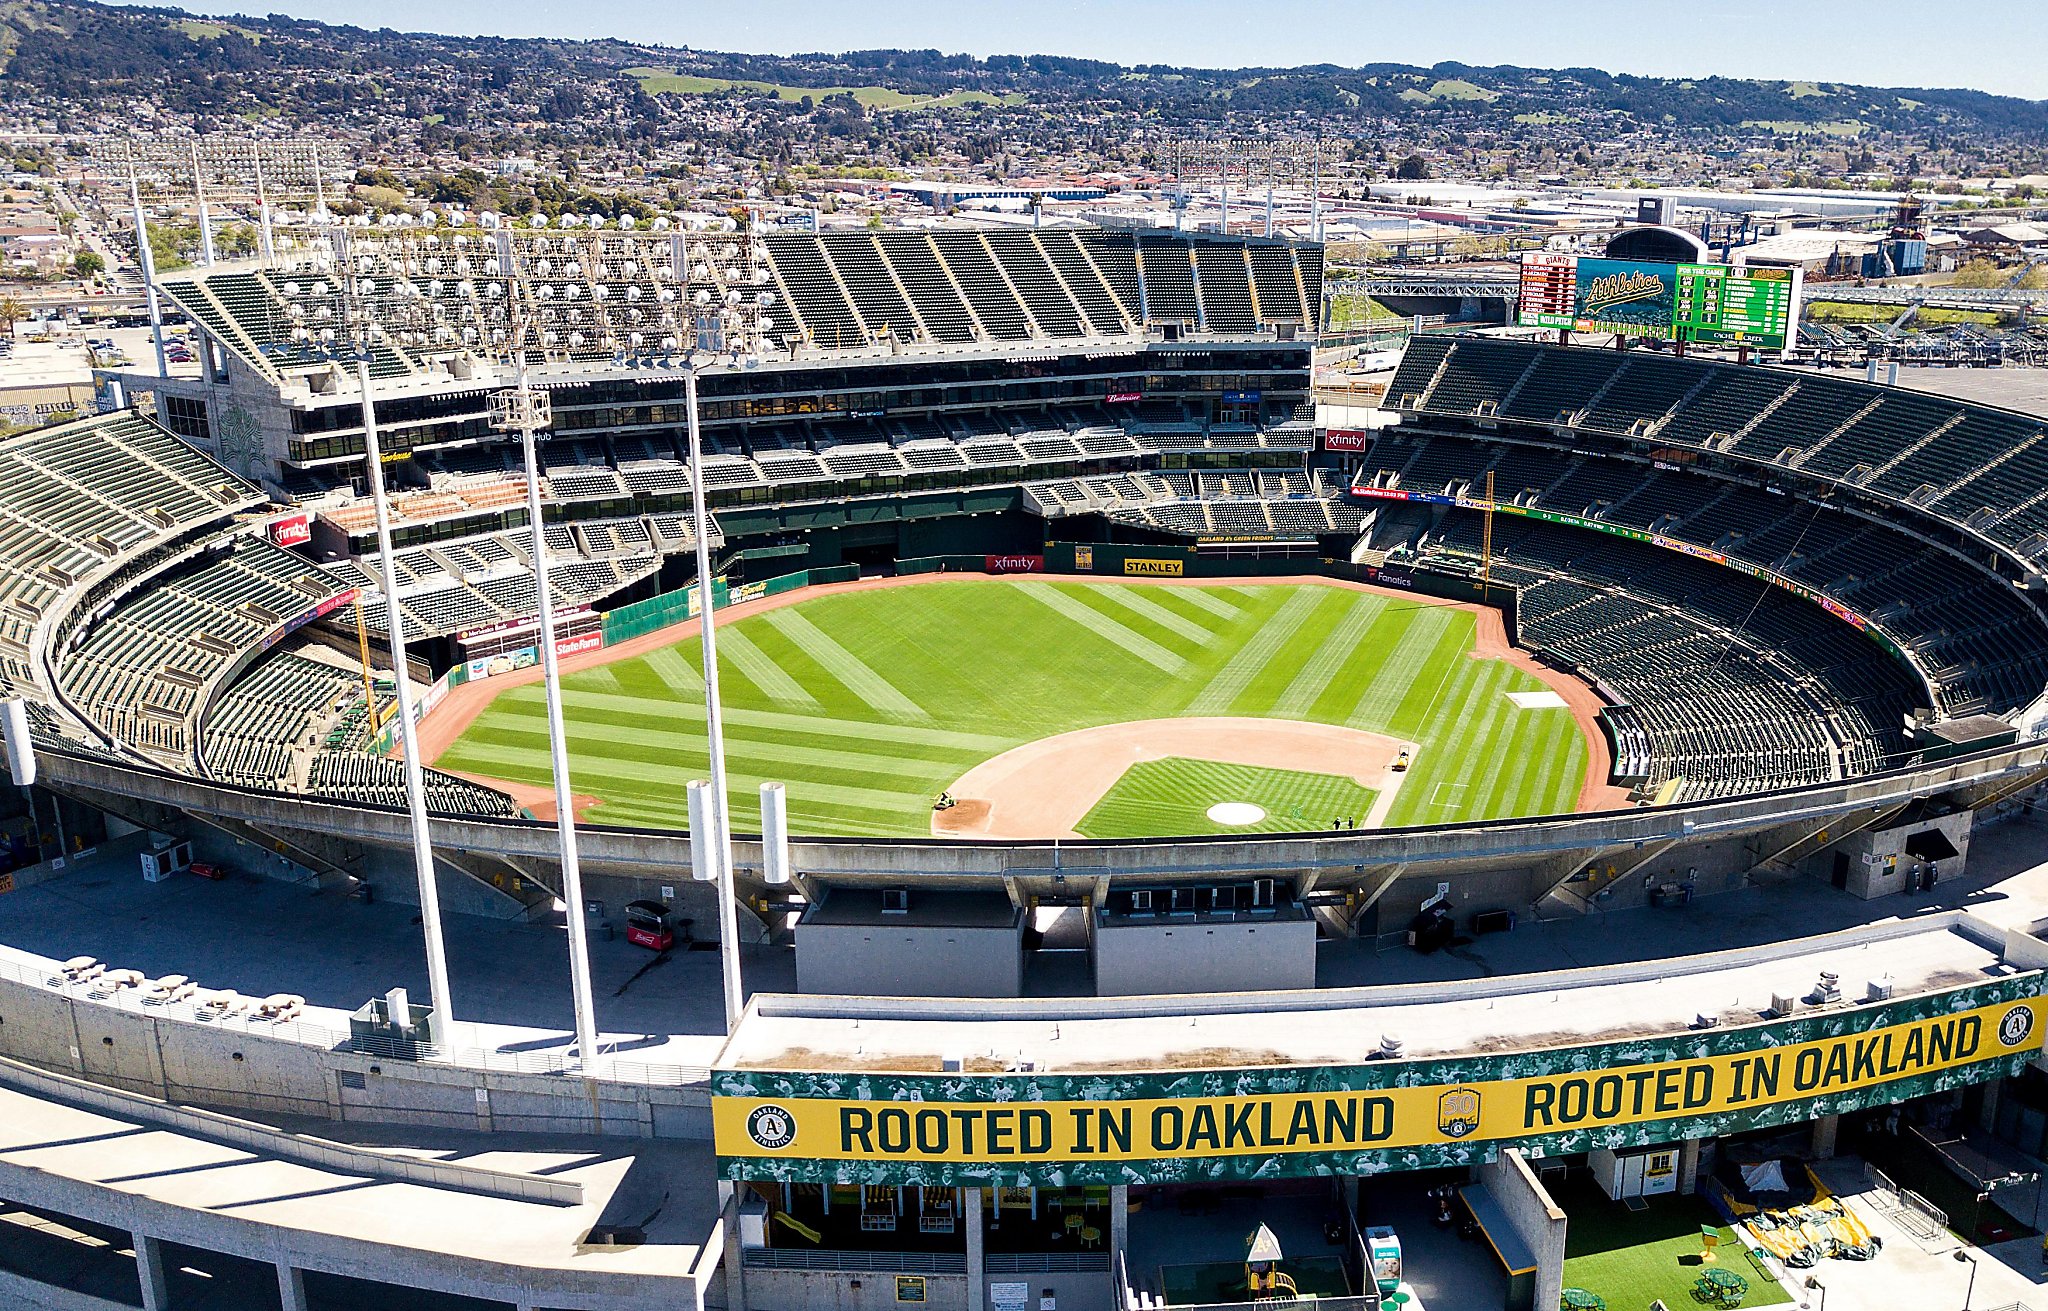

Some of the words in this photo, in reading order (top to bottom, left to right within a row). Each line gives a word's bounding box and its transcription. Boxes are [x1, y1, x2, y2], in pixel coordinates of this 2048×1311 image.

[1545, 256, 1571, 266] GIANTS
[1584, 269, 1659, 303] Athletics
[1555, 316, 1573, 326] PITCH
[1714, 332, 1734, 340] CACHE
[1743, 334, 1763, 342] CREEK
[1107, 394, 1141, 402] Budweiser
[1329, 434, 1363, 448] xfinity
[995, 556, 1035, 571] xfinity
[1126, 561, 1181, 573] STANLEY
[1378, 571, 1412, 587] Fanatics
[731, 592, 765, 604] CALIFORNIA
[495, 623, 508, 631] Bank
[2005, 1007, 2030, 1021] OAKLAND
[2001, 1030, 2028, 1045] ATHLETICS
[1523, 1064, 1715, 1129] ROOTED
[1726, 1053, 1780, 1103] IN
[1793, 1014, 1982, 1091] OAKLAND
[1444, 1094, 1475, 1116] 50
[752, 1106, 788, 1120] OAKLAND
[764, 1117, 782, 1136] A's
[839, 1107, 1053, 1155] ROOTED
[1069, 1107, 1132, 1154] IN
[1150, 1096, 1395, 1152] OAKLAND
[753, 1133, 791, 1148] ATHLETICS
[1254, 1237, 1272, 1253] A's
